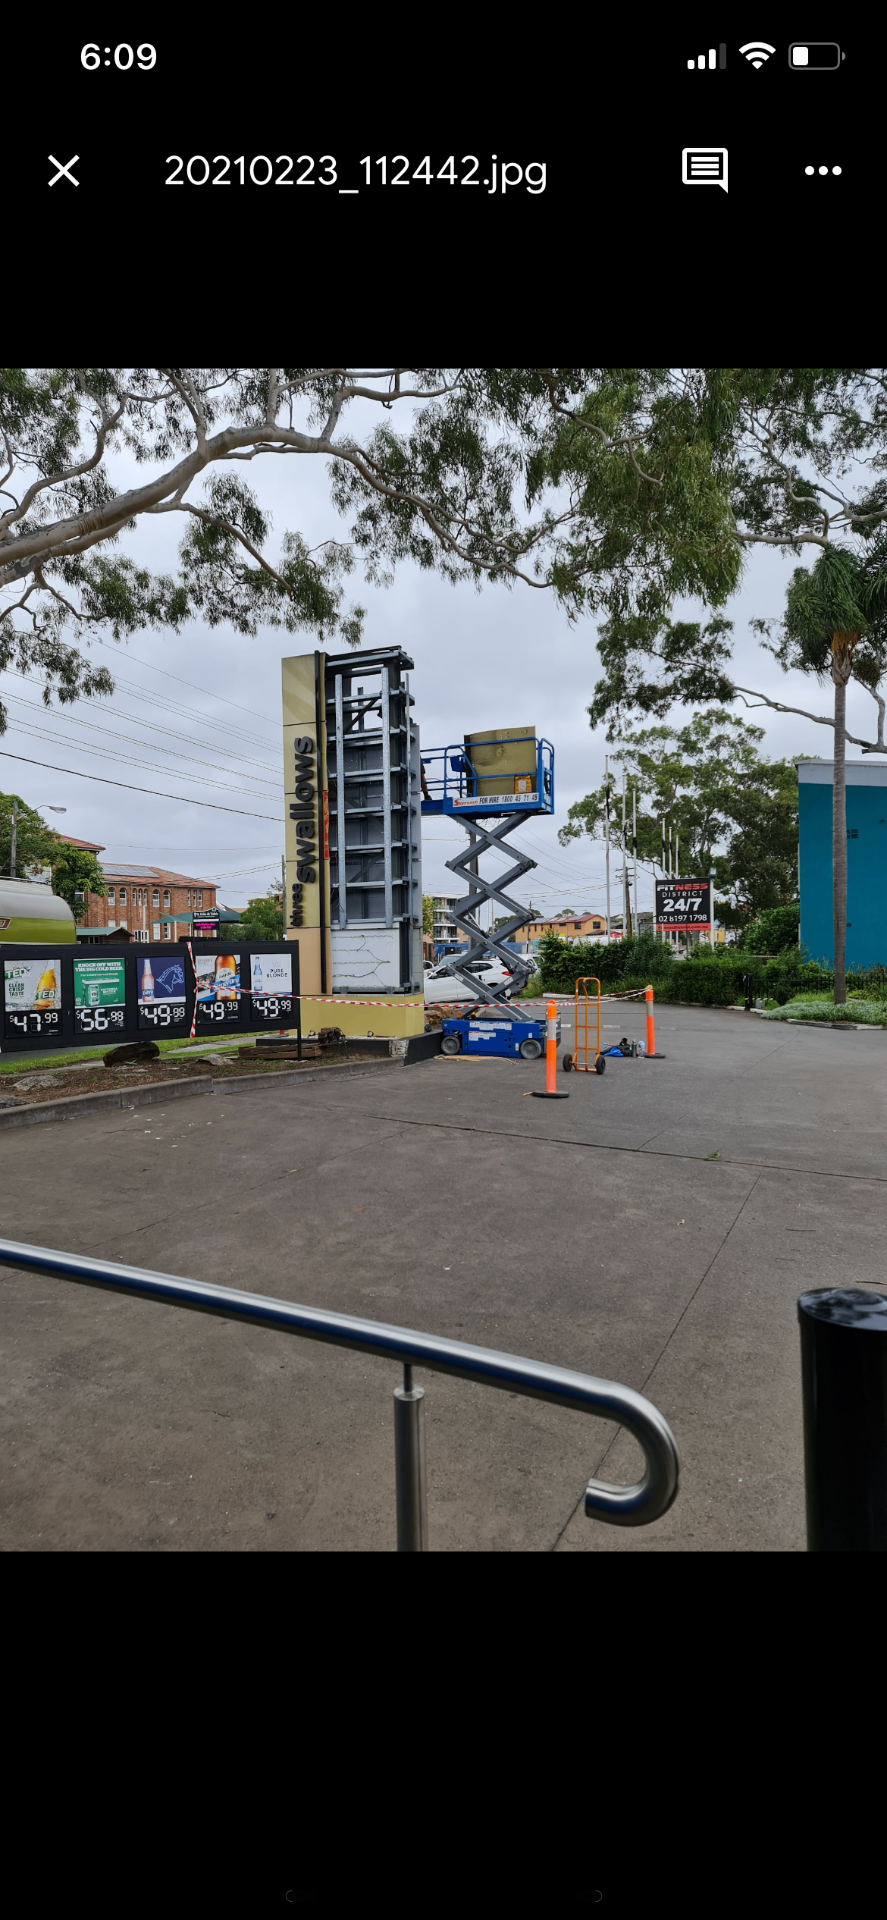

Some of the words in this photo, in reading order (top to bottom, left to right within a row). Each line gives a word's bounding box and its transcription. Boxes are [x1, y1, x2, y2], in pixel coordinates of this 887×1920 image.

[289, 735, 316, 884] swallows
[657, 883, 708, 891] FITNESS
[290, 883, 303, 927] three
[663, 898, 702, 912] 24/7
[9, 1012, 58, 1032] $47.99
